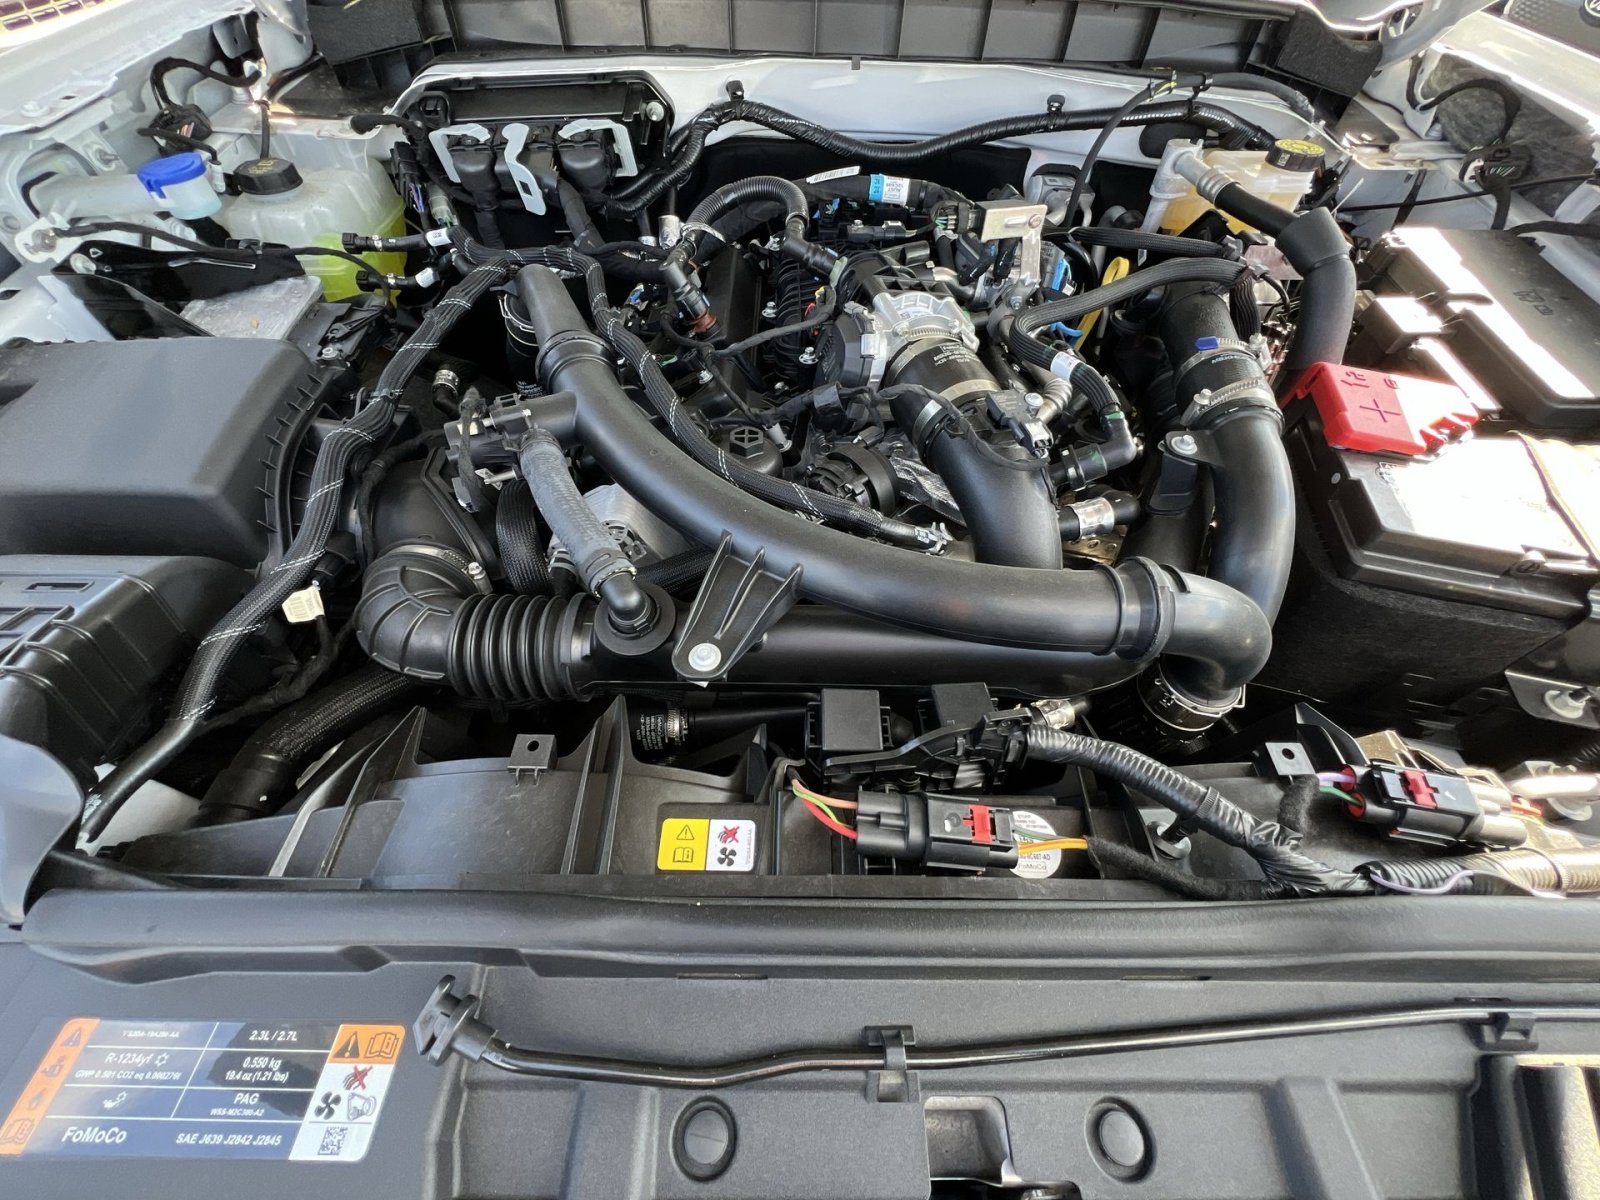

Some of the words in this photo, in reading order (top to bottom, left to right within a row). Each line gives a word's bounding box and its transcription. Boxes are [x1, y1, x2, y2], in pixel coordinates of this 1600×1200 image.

[249, 1030, 270, 1041] 2.3L
[277, 1031, 298, 1042] 2.7L
[105, 1052, 154, 1067] R-1234yf
[242, 1057, 268, 1068] 0.550
[269, 1058, 282, 1070] kg
[116, 1071, 133, 1079] CO2
[134, 1073, 145, 1081] eq
[225, 1071, 241, 1080] 19.4
[242, 1073, 252, 1081] oz
[252, 1071, 271, 1083] (1.21
[272, 1071, 289, 1083] lbs)
[233, 1093, 259, 1104] PAG
[61, 1127, 128, 1144] FoMoCo
[176, 1133, 198, 1145] SAE
[199, 1134, 222, 1145] J639
[224, 1134, 252, 1146] J2842
[253, 1134, 282, 1146] J2845
